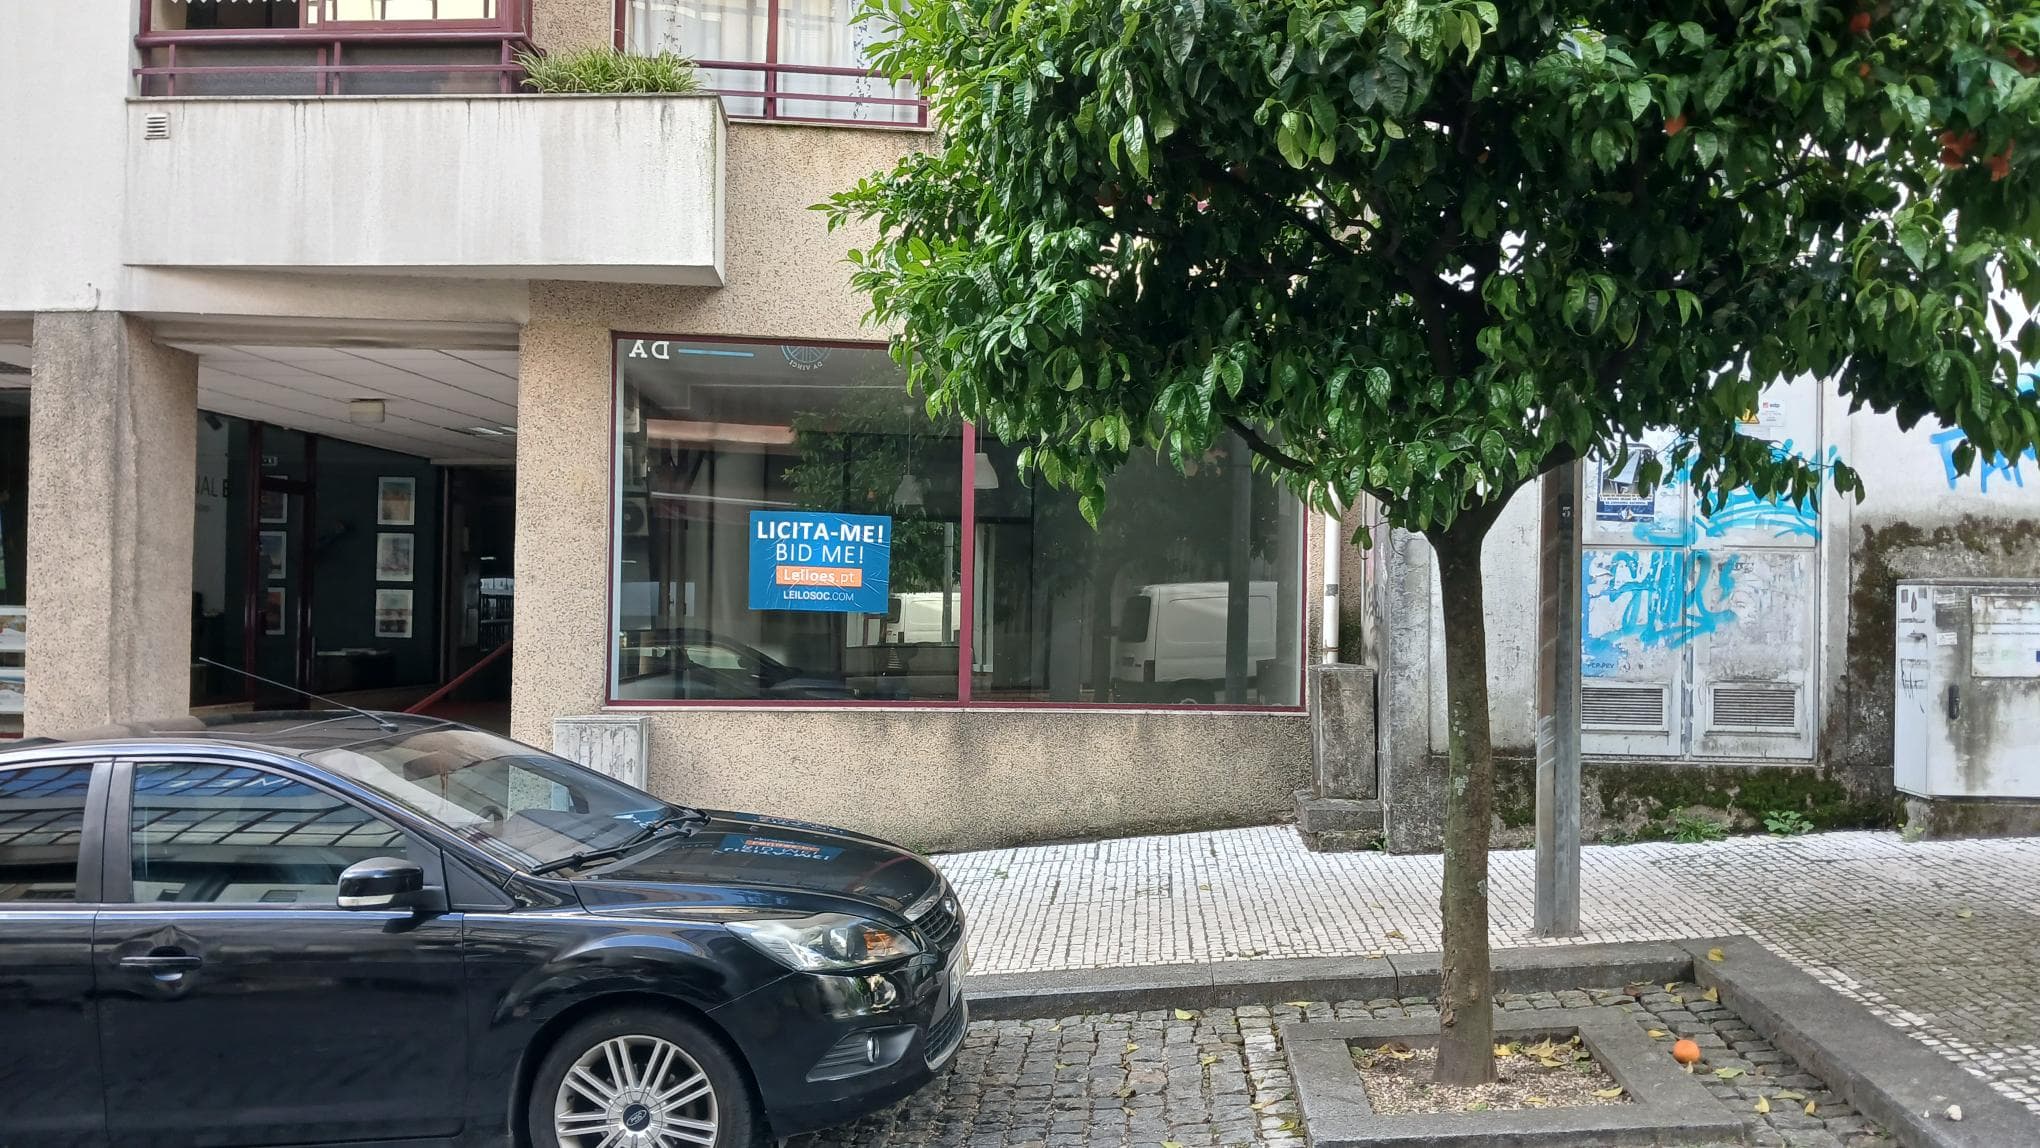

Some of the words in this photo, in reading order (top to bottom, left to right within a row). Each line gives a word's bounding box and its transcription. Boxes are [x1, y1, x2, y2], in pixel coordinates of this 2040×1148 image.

[757, 520, 884, 543] LICITA-ME!
[776, 543, 813, 562] BID
[822, 545, 864, 564] ME!
[784, 568, 855, 584] Leiloes.pt
[783, 590, 854, 601] LEILOSOC.COM
